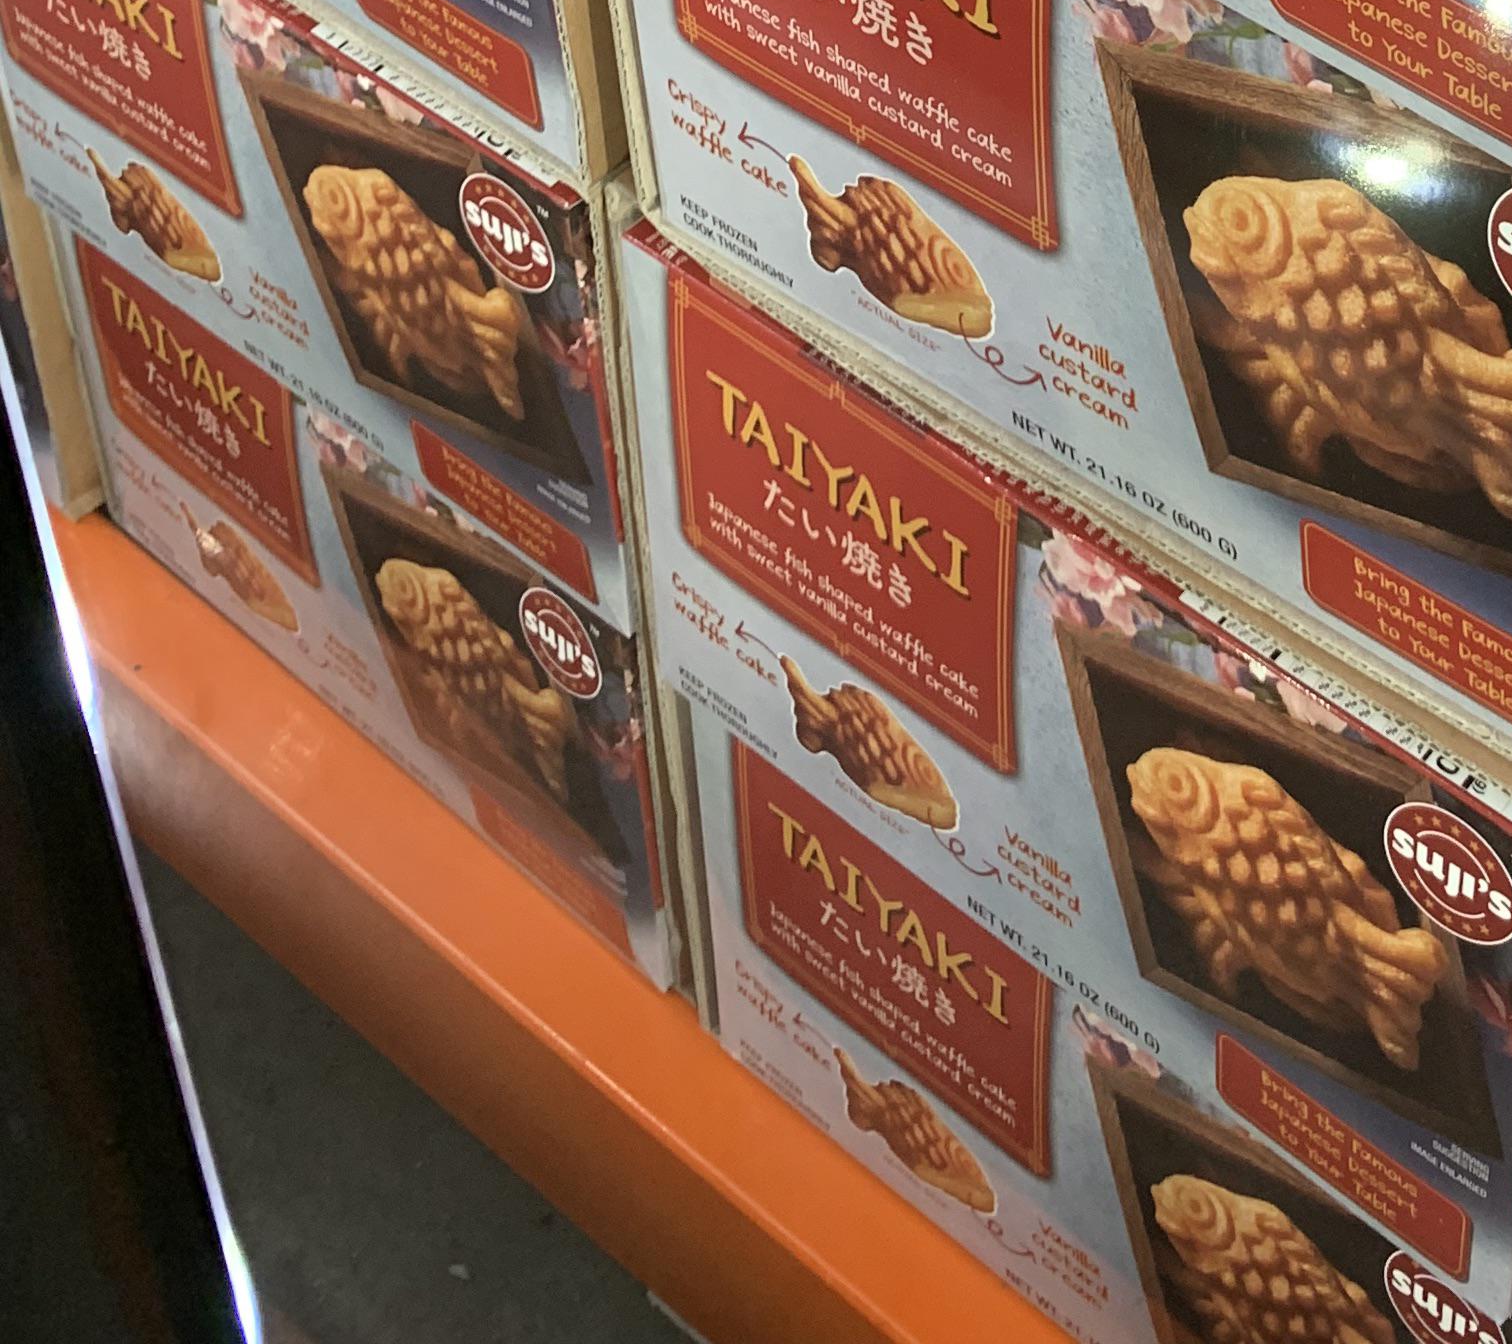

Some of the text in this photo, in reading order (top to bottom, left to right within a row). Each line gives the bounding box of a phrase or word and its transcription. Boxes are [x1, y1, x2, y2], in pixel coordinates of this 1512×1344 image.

[1347, 18, 1505, 122] to Your Table
[465, 198, 549, 269] suji's
[102, 274, 274, 449] TAIYAKI
[705, 369, 972, 601] TAIYAKI
[525, 608, 597, 681] suji's
[768, 802, 1010, 1027] TAIYAKI
[1391, 823, 1512, 922] suji's
